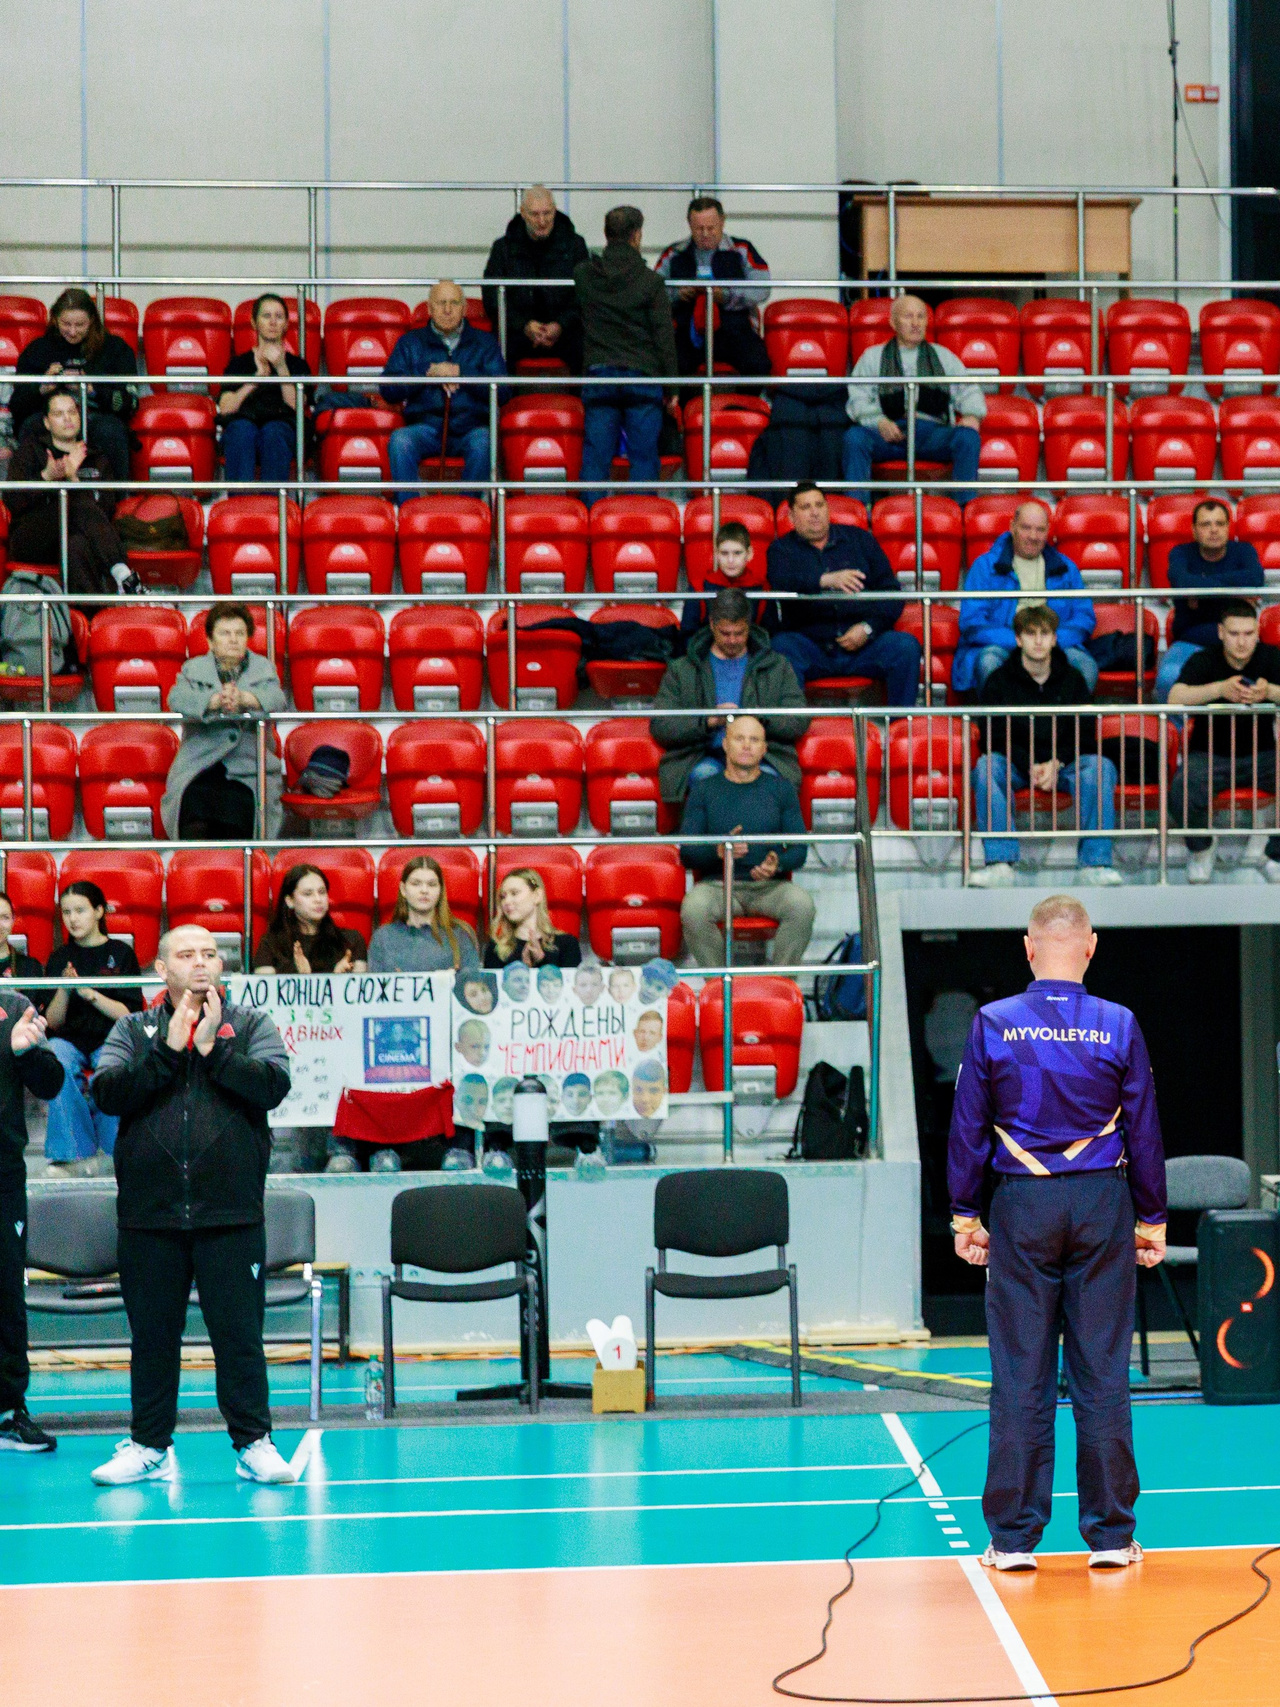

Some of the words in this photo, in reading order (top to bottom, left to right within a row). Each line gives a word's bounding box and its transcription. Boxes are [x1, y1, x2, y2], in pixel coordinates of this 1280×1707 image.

[277, 978, 333, 1007] КОНЦА
[344, 976, 434, 1005] СЮЖЕТА
[511, 1005, 626, 1040] РОЖДЕНЫ
[278, 1024, 343, 1044] АВНЫХ
[1003, 1027, 1111, 1044] MYVOLLEY.RU
[378, 1053, 417, 1063] CINEMA
[498, 1038, 627, 1075] ЧЕМПИОНАМИ
[613, 1344, 621, 1359] 1
